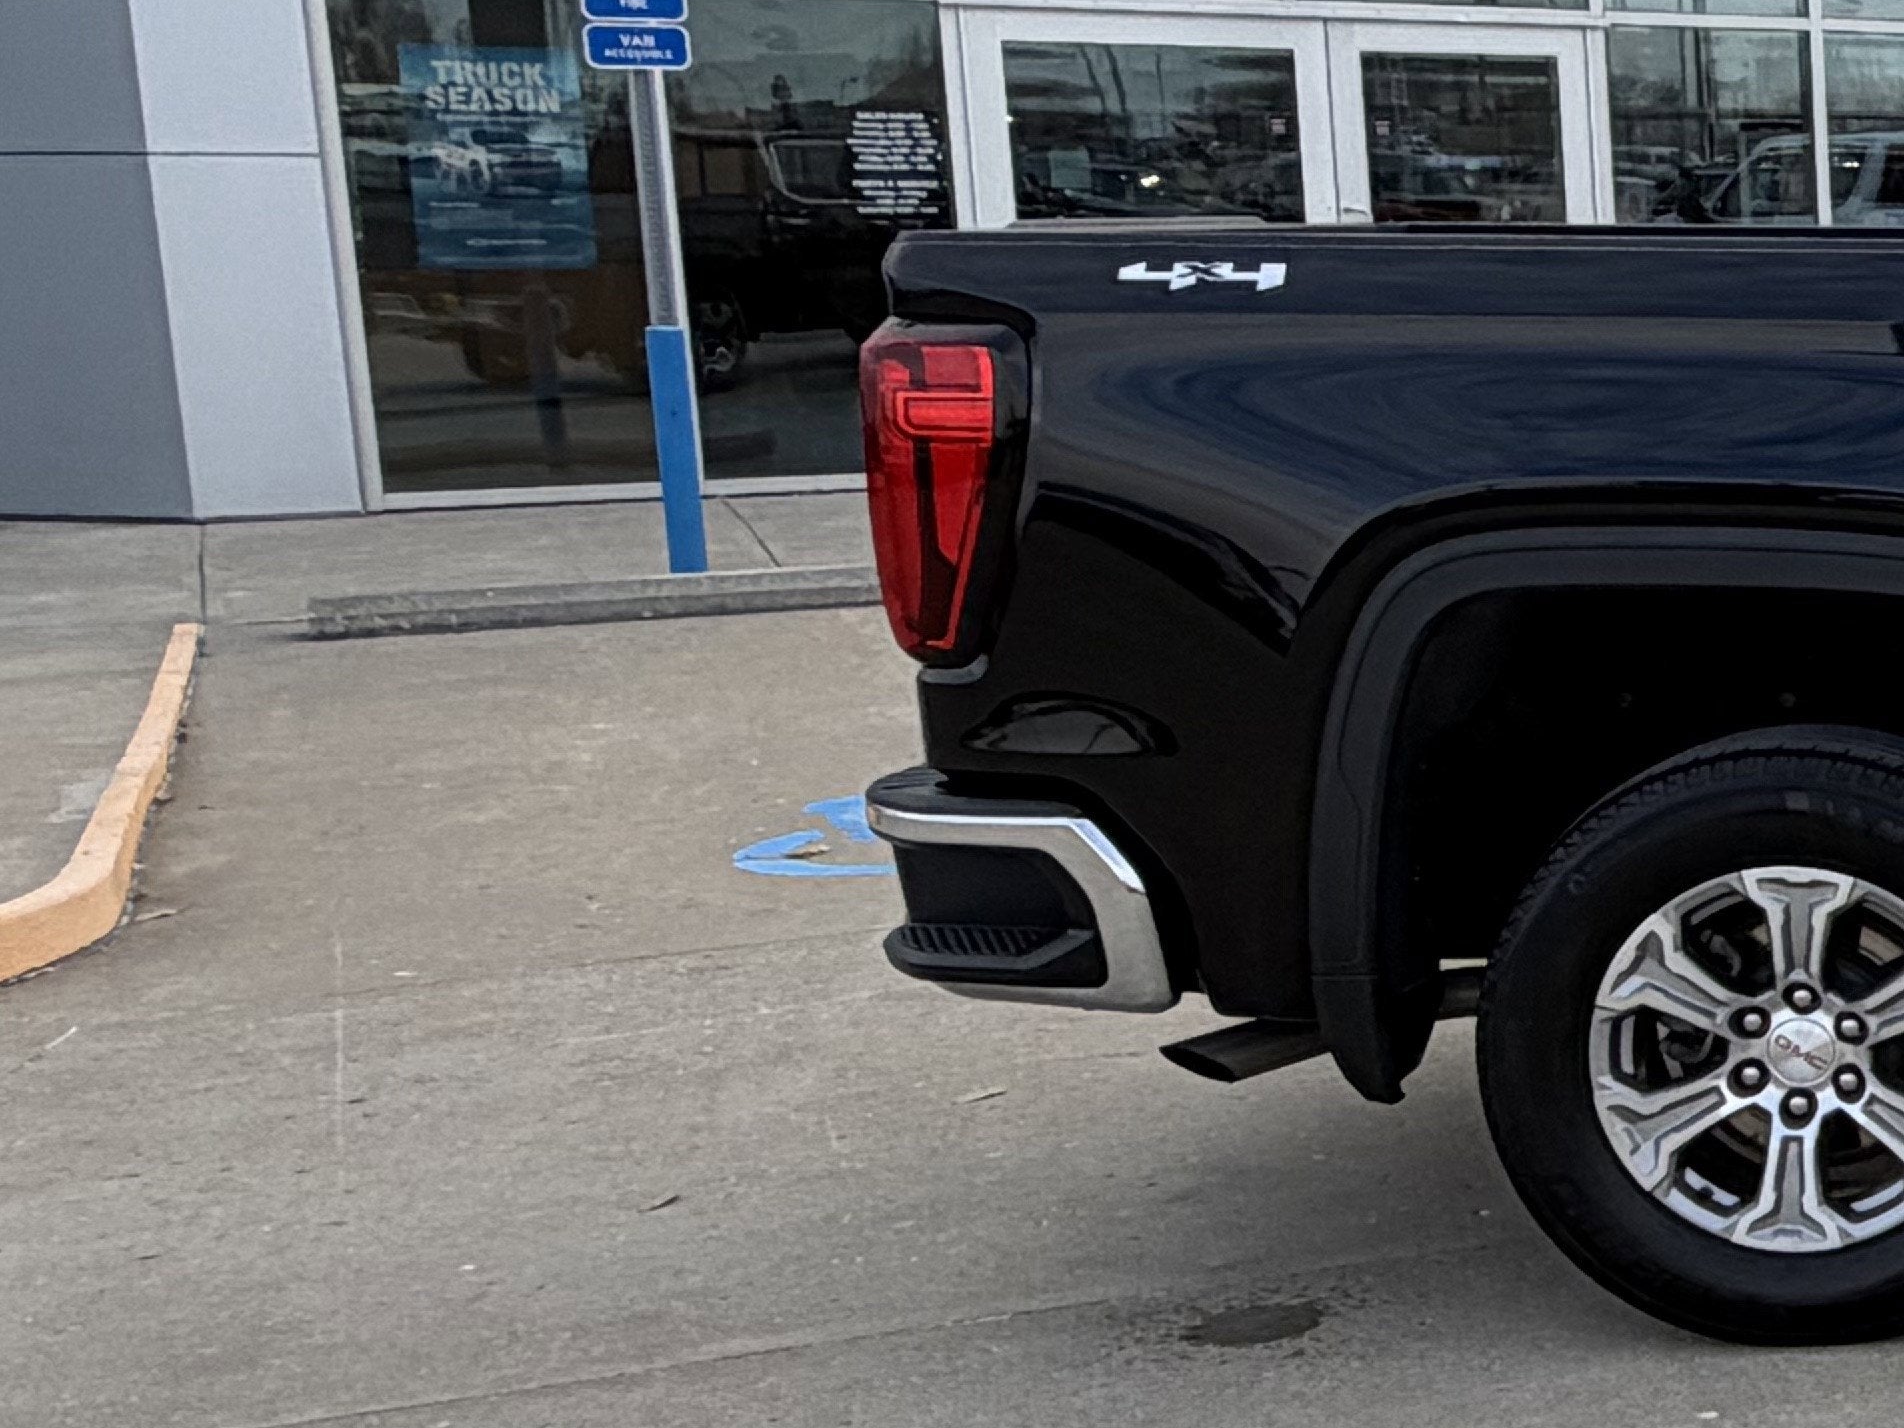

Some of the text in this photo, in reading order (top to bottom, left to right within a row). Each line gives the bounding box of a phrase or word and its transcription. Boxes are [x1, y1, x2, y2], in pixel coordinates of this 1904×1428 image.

[619, 34, 656, 48] VAN
[430, 60, 547, 87] TRUCK
[424, 85, 562, 113] SEASON
[1775, 1034, 1828, 1070] GMC
